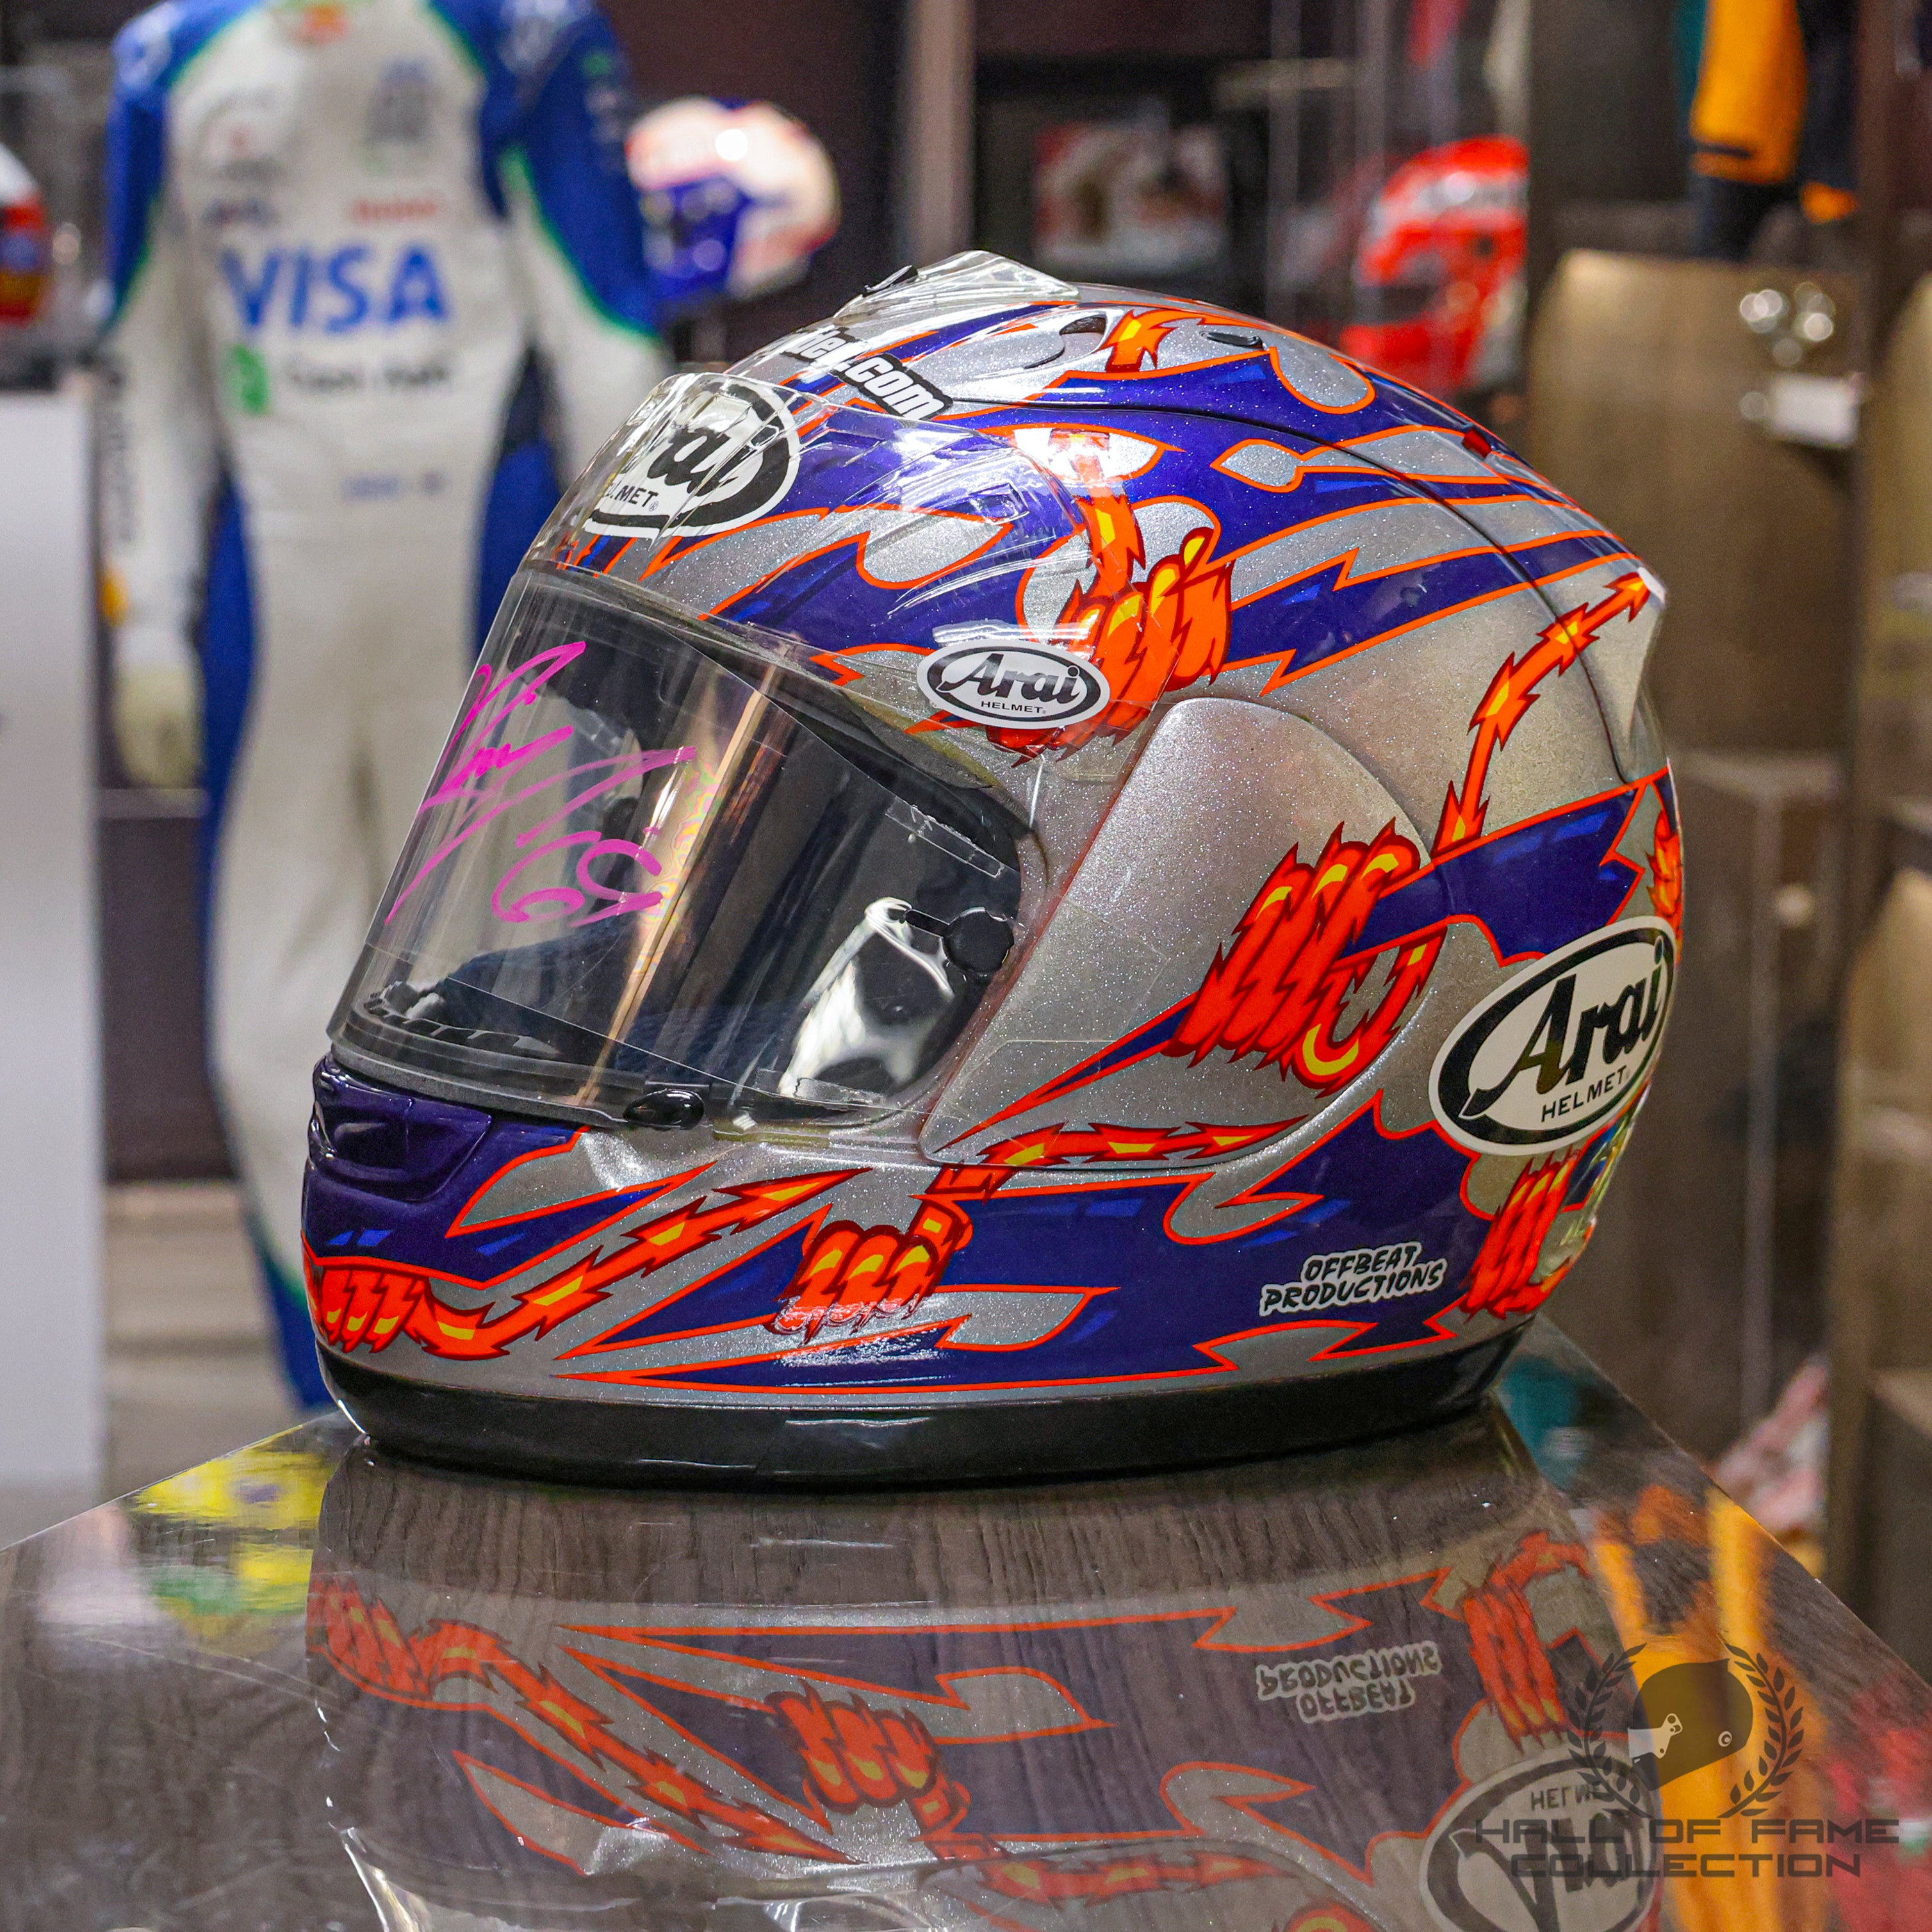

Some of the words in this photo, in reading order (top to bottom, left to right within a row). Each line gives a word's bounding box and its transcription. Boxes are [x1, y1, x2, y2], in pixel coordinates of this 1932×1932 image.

[220, 244, 448, 332] VISA
[936, 653, 1081, 705] Arai
[980, 700, 1044, 714] HELMET
[1459, 937, 1664, 1119] Arai
[1541, 1065, 1628, 1123] HELMET
[1264, 1261, 1443, 1312] PRODUCTIONS
[1304, 1245, 1418, 1281] OFFBEAT
